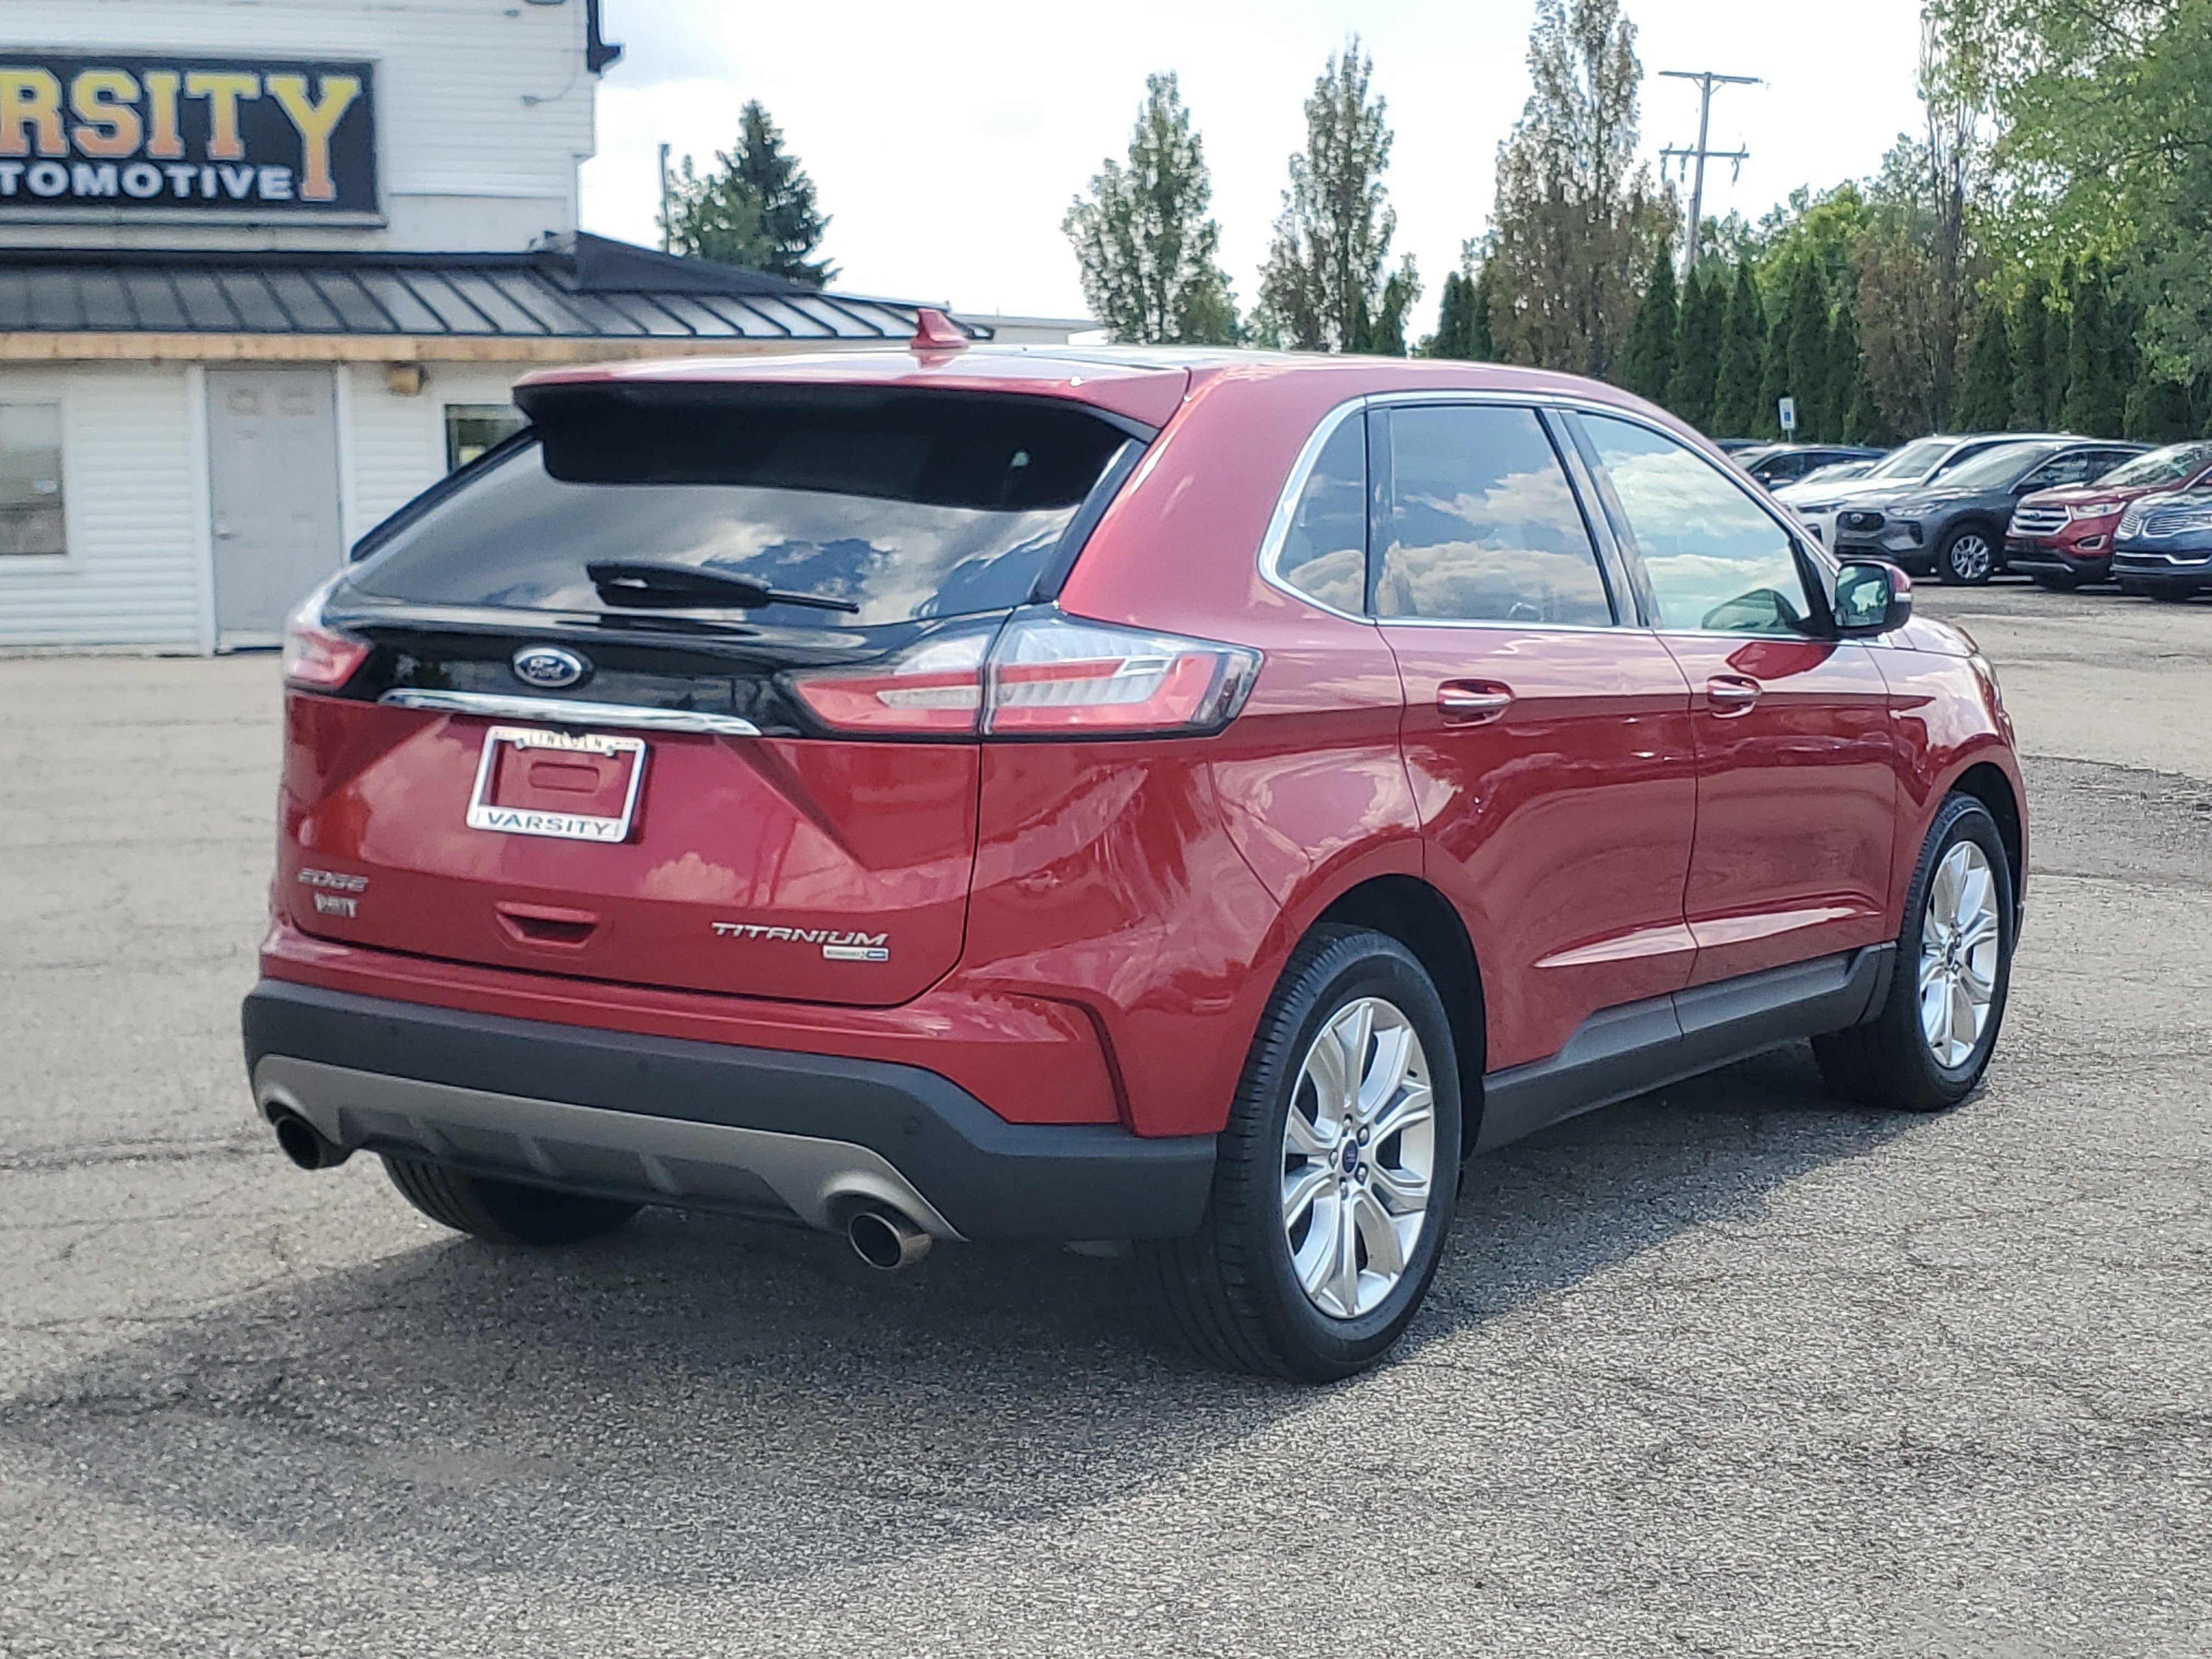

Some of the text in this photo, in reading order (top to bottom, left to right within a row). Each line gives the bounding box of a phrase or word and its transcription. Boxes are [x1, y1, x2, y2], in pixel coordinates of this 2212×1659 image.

[0, 66, 362, 201] RSITY
[0, 162, 294, 200] TOMOTIVE
[488, 811, 611, 836] VARSITY
[712, 921, 888, 946] TITANIUM
